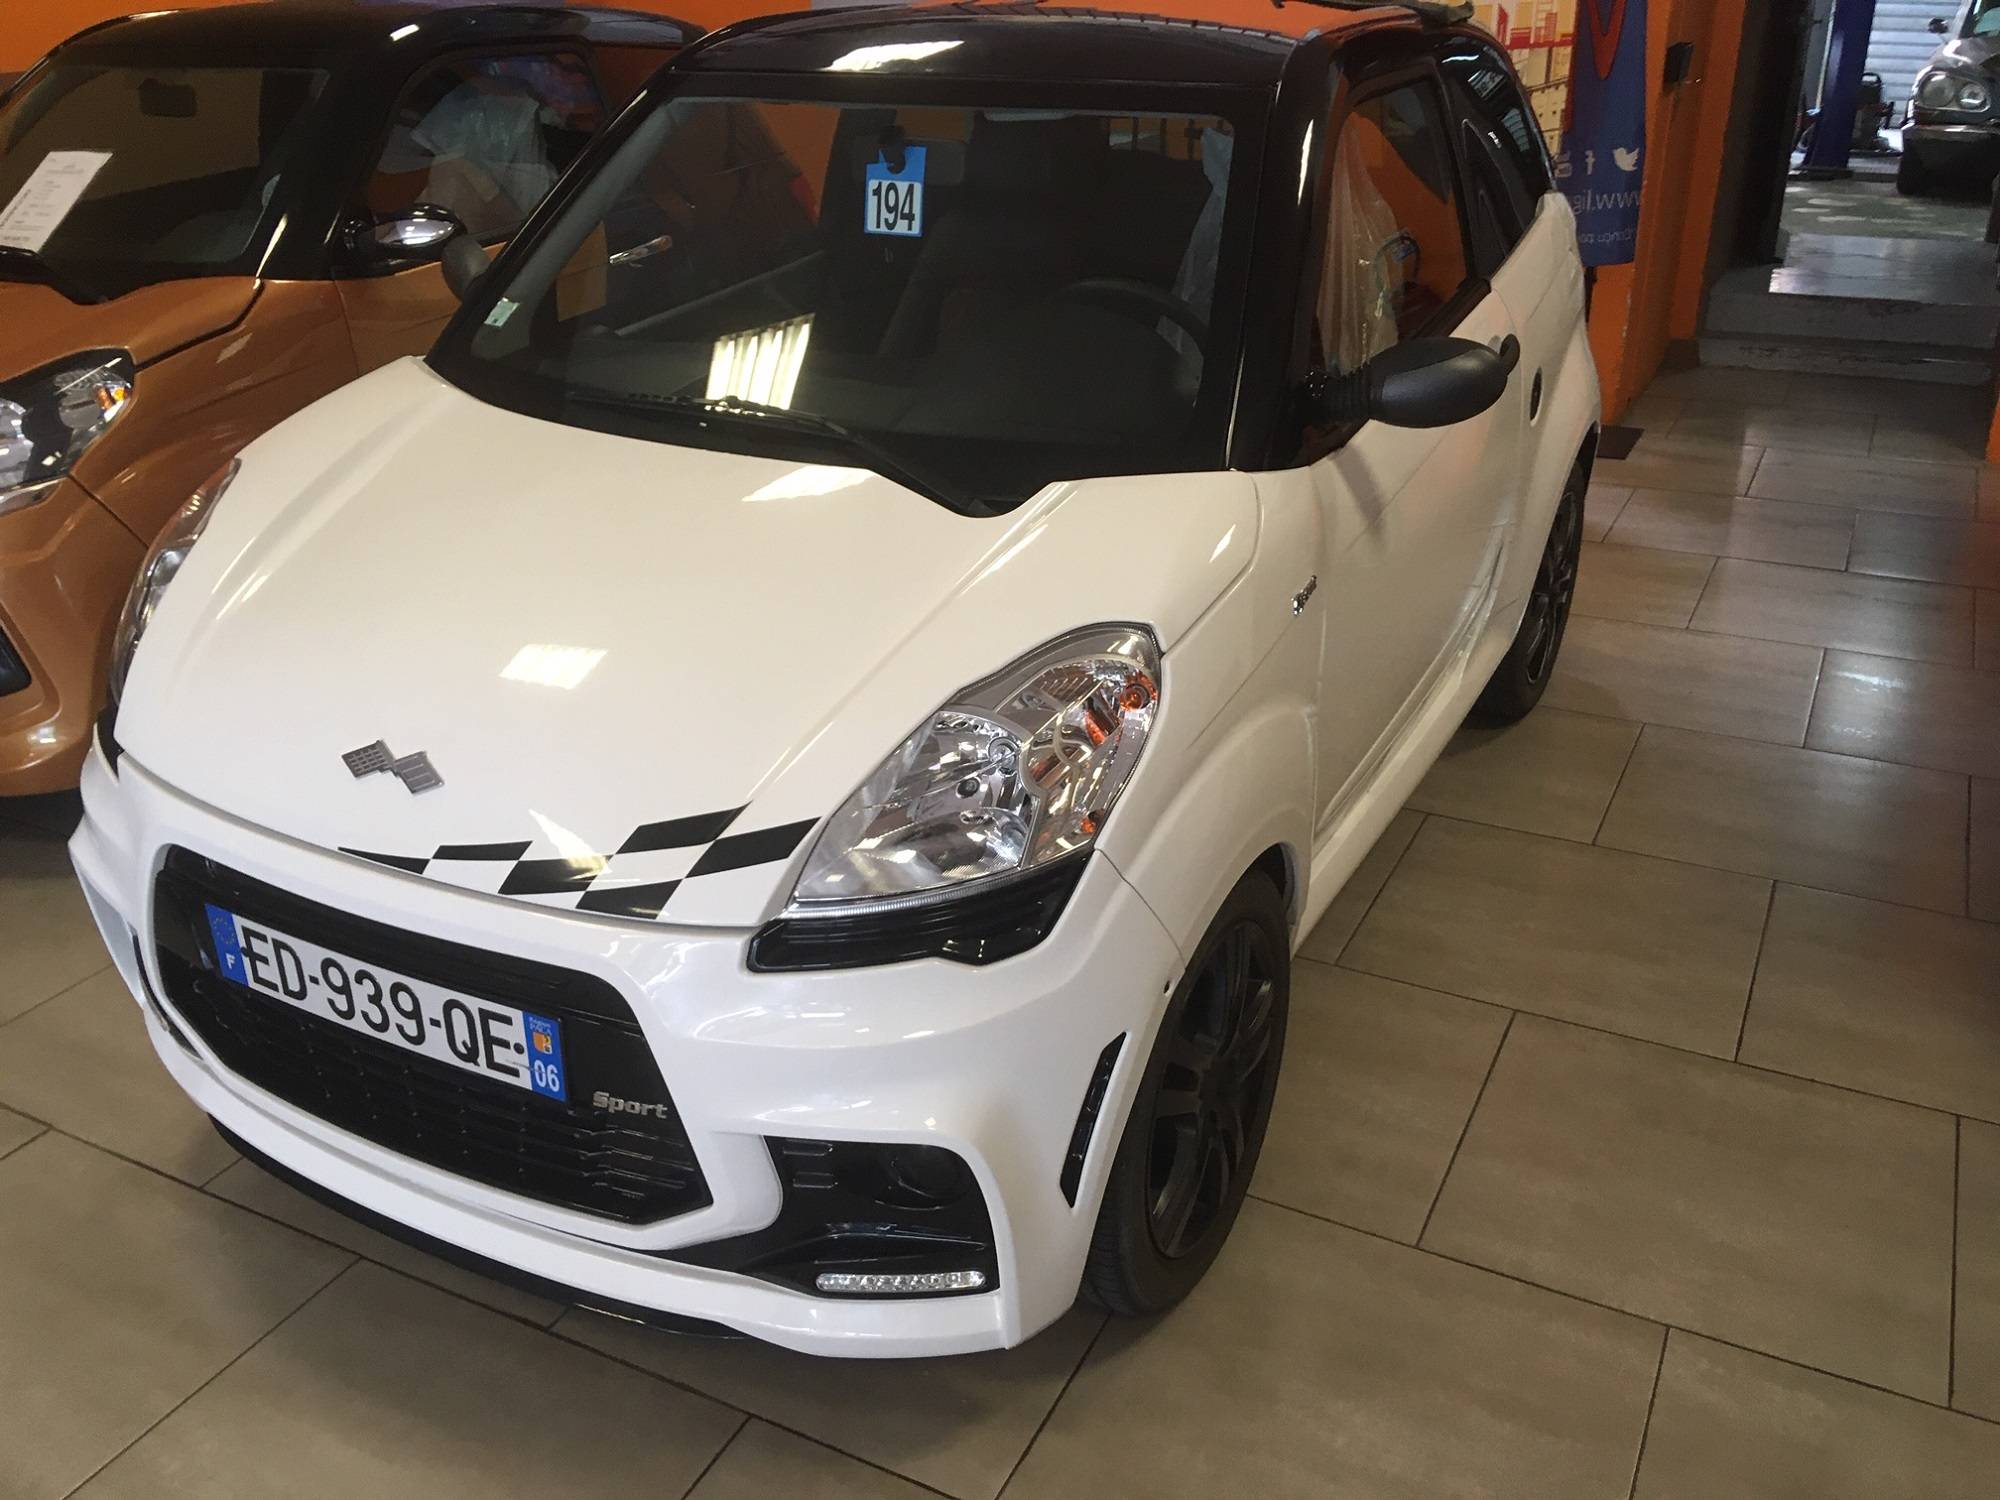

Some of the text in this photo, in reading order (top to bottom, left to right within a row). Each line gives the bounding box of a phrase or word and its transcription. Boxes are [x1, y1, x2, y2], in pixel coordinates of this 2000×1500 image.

[872, 181, 915, 231] 194
[226, 953, 236, 969] F
[241, 925, 521, 1079] ED-939-QE
[534, 1059, 560, 1092] 06
[592, 1090, 668, 1119] Sport
